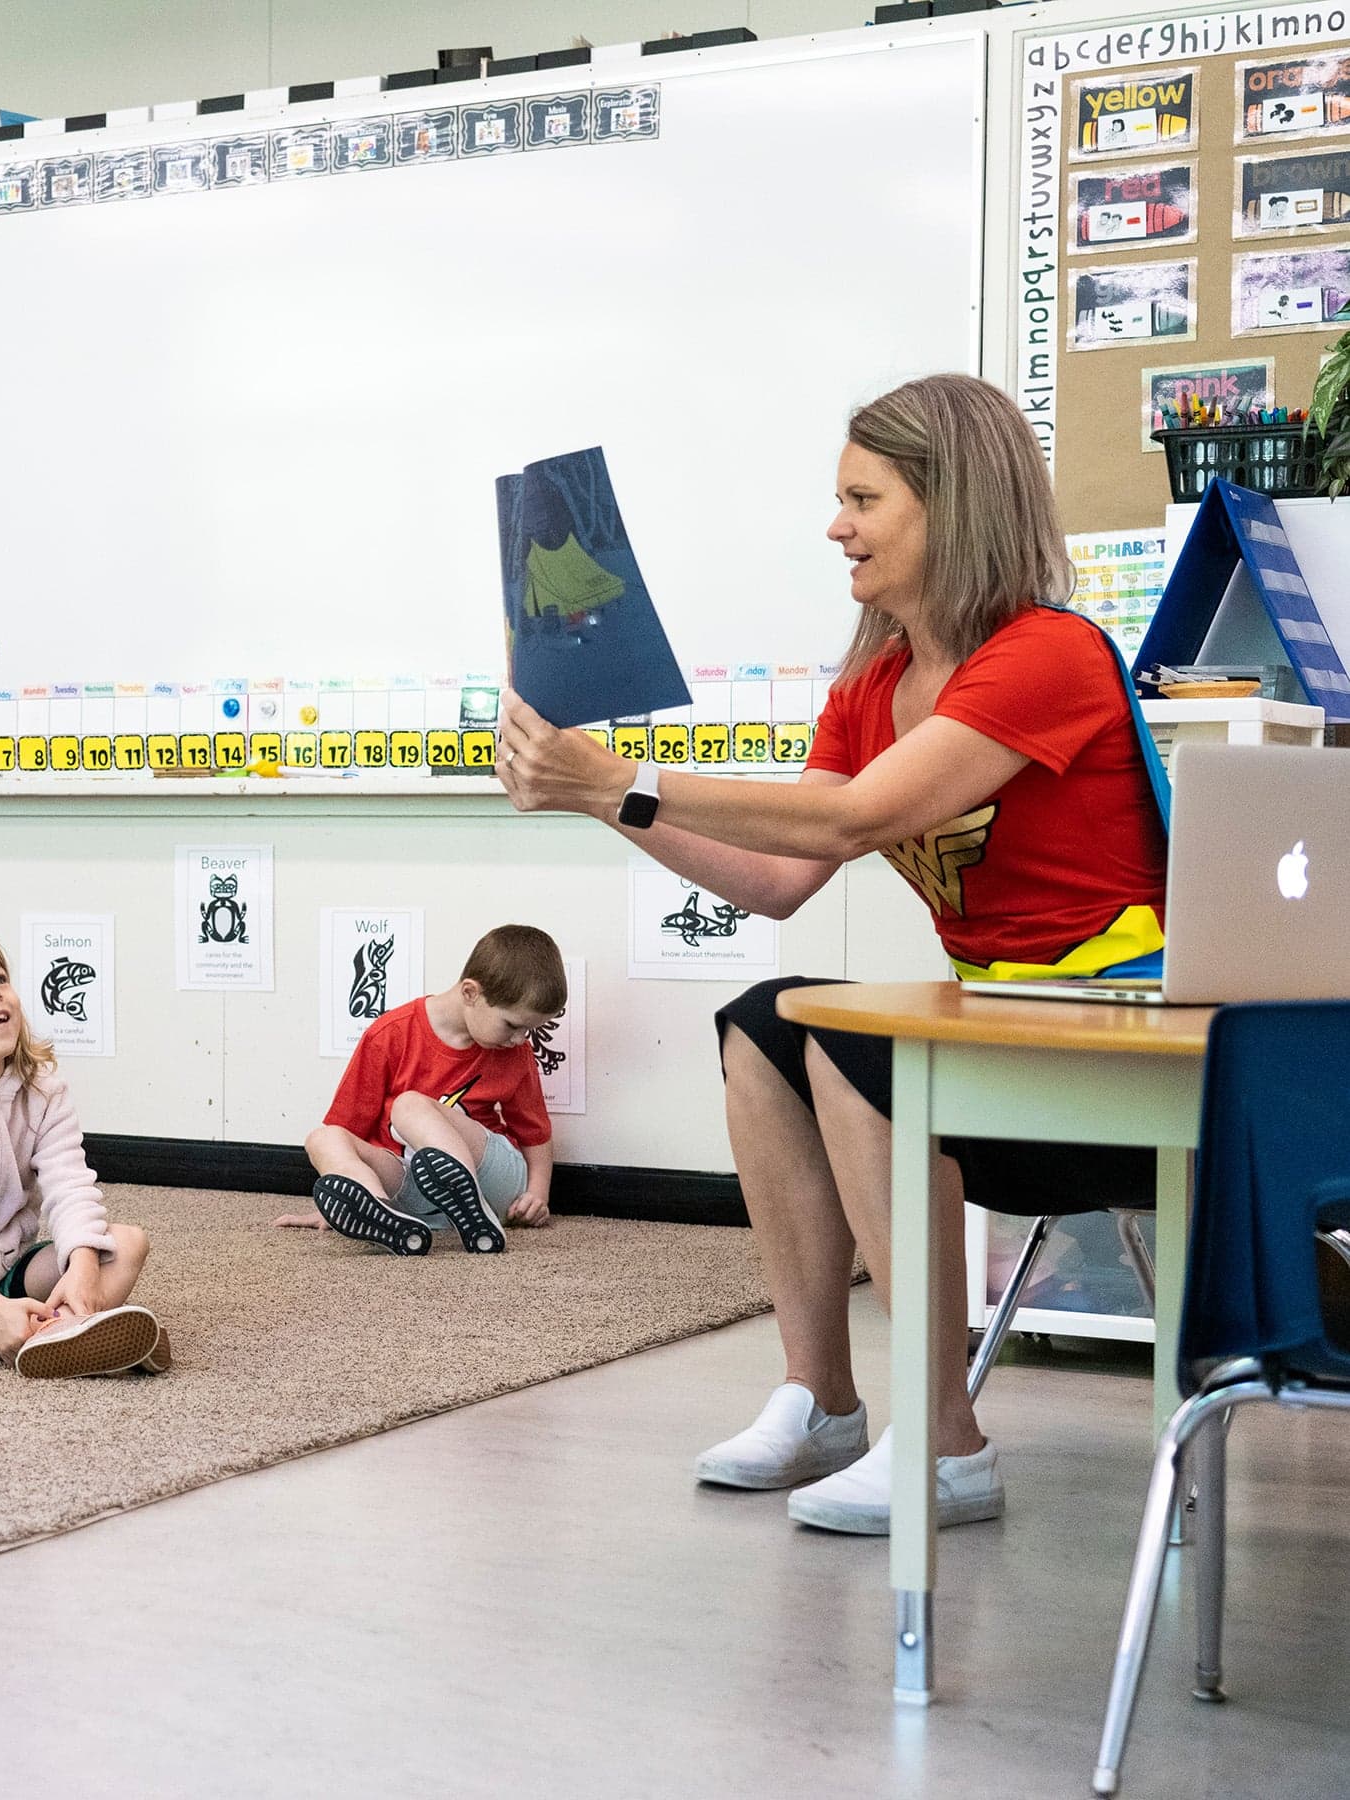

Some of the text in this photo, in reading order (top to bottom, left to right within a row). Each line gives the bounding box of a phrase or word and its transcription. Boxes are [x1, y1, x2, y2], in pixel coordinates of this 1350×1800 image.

[1249, 59, 1350, 92] orag
[1085, 83, 1186, 119] yellow
[548, 105, 567, 114] Music
[1105, 173, 1162, 203] red
[1173, 369, 1241, 399] pink
[695, 667, 727, 679] Saturday
[739, 666, 767, 677] nday
[778, 665, 808, 675] Monday
[54, 686, 78, 694] Tuesday
[154, 685, 173, 695] Friday
[2, 750, 11, 767] 7
[35, 750, 44, 766] 8
[66, 750, 76, 766] 9
[90, 749, 108, 766] 10
[124, 749, 141, 765] 11
[155, 749, 175, 765] 12
[188, 748, 208, 765] 13
[221, 747, 242, 763] 14
[258, 746, 278, 762] 15
[293, 747, 313, 764] 16
[328, 745, 348, 763] 17
[363, 745, 383, 763] 18
[398, 745, 419, 763] 19
[432, 744, 456, 762] 20
[472, 744, 492, 763] 21
[620, 738, 807, 759] 25 26 27 28 29
[201, 856, 247, 870] Beaver
[355, 919, 389, 934] Wolf
[44, 934, 92, 948] Salmon
[661, 950, 745, 958] know about themselves
[195, 961, 253, 970] community and the
